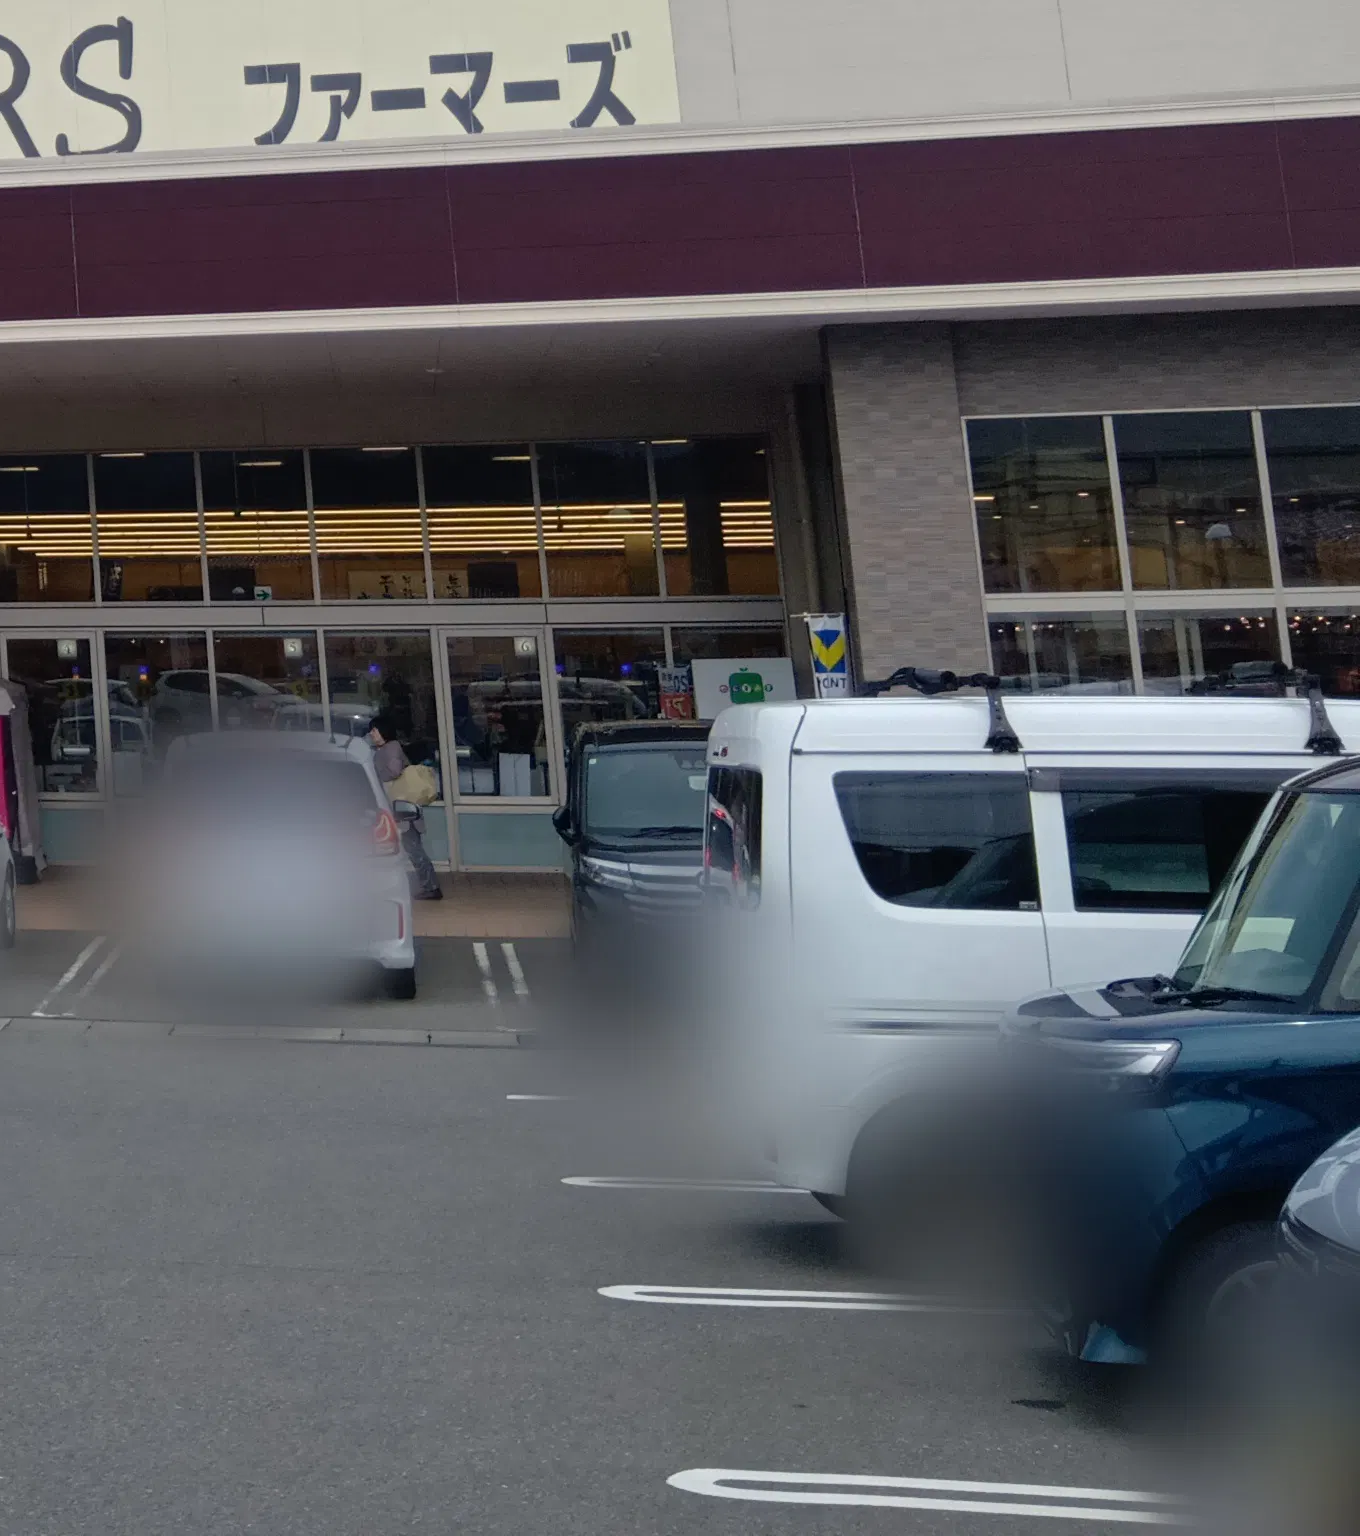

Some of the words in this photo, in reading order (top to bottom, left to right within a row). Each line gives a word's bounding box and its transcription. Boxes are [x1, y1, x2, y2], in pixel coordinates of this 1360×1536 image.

[243, 30, 633, 148] ファーマーズ
